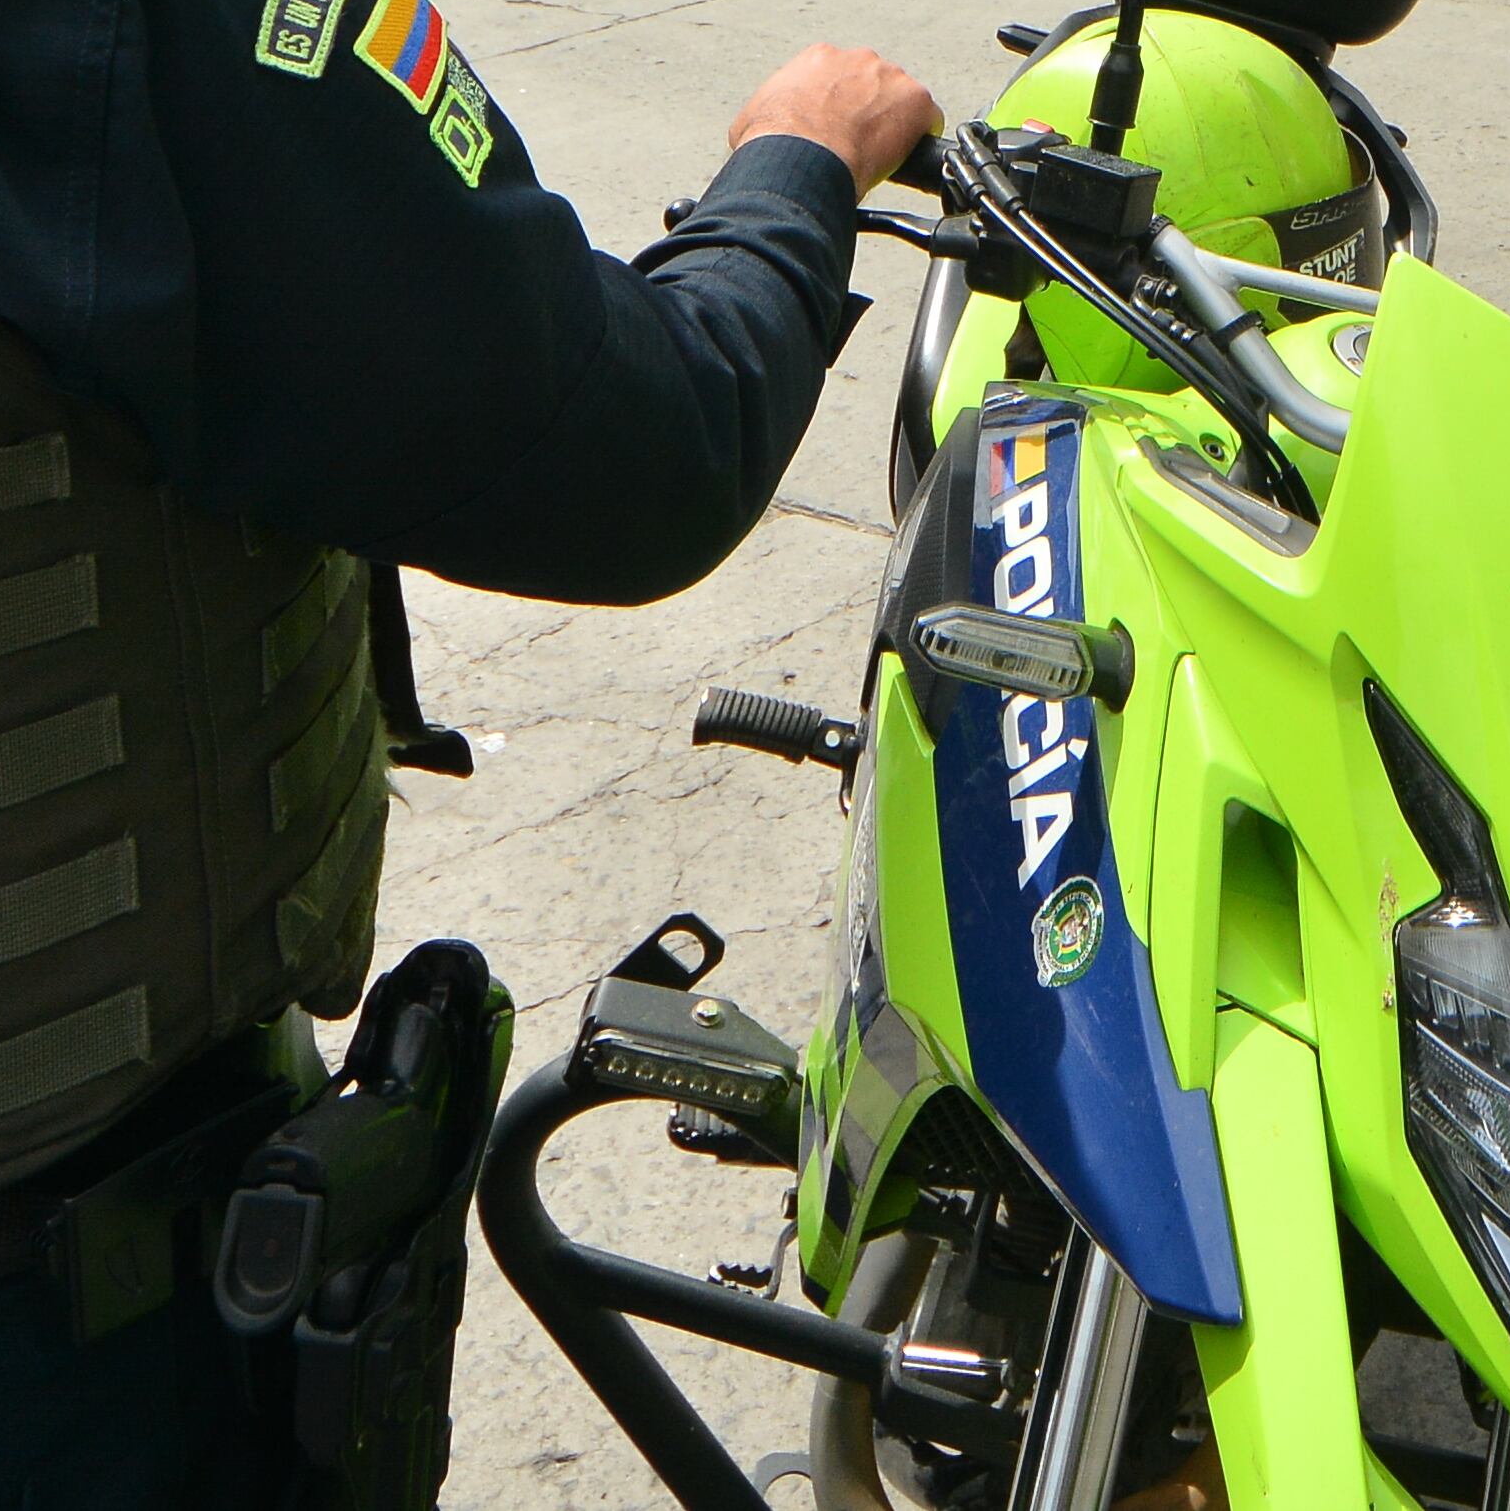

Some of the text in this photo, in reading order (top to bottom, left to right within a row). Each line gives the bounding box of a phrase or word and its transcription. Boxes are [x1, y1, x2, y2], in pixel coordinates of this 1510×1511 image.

[276, 29, 312, 59] ES
[1299, 237, 1358, 277] STUNT
[991, 480, 1087, 890] POCÍA
